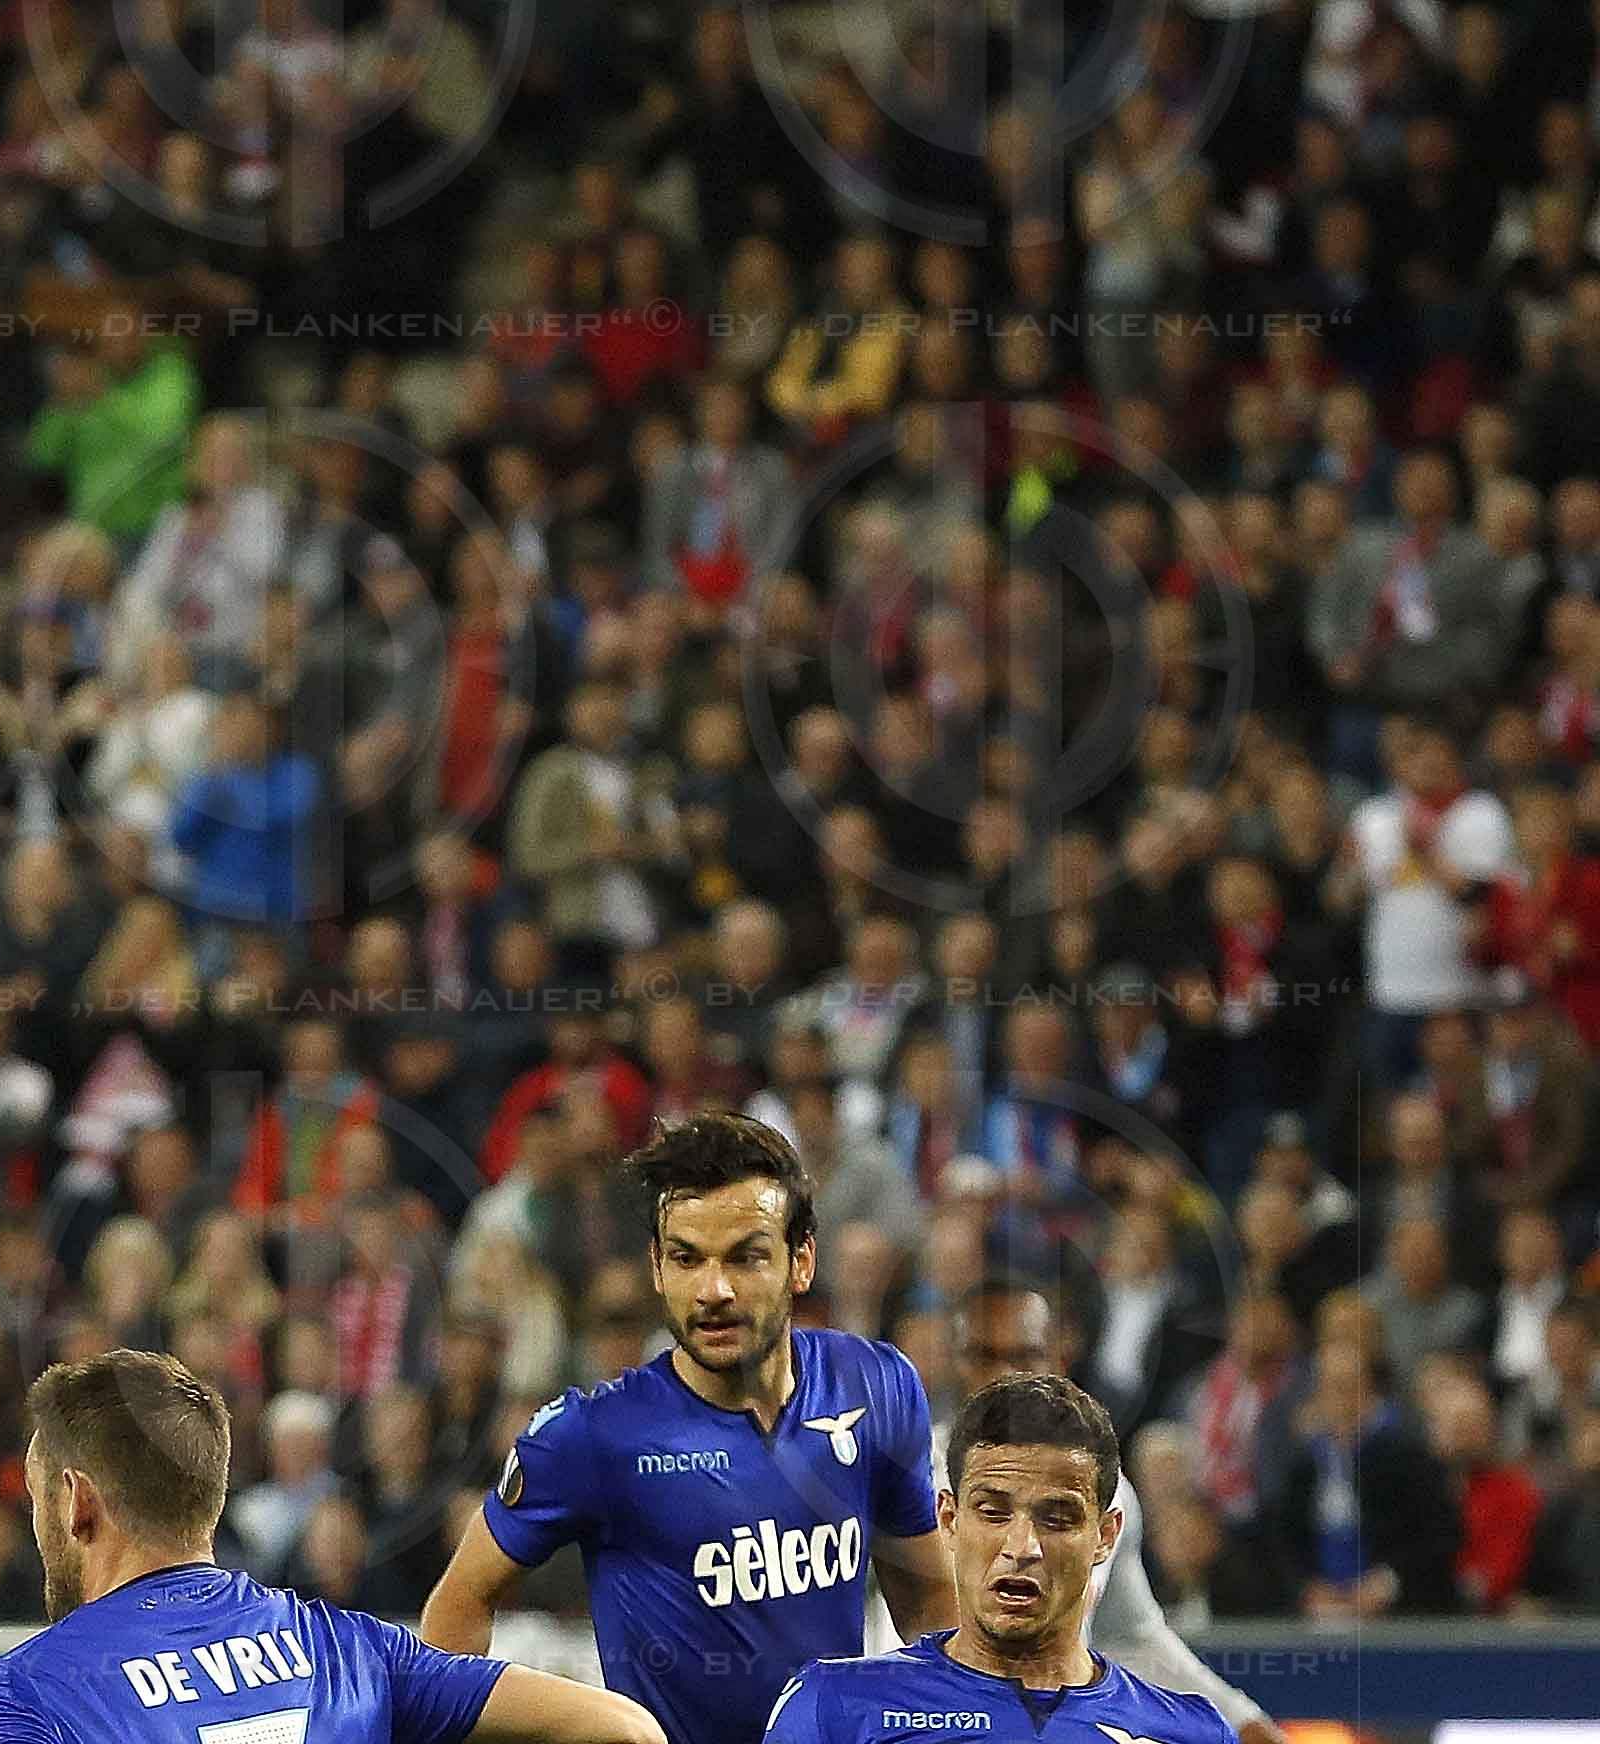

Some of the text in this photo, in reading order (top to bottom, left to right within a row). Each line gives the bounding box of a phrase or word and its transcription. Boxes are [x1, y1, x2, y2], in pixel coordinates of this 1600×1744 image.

[638, 1450, 730, 1474] macron
[121, 1652, 199, 1709] DE
[192, 1629, 314, 1696] VRIJ
[883, 1711, 992, 1731] macron
